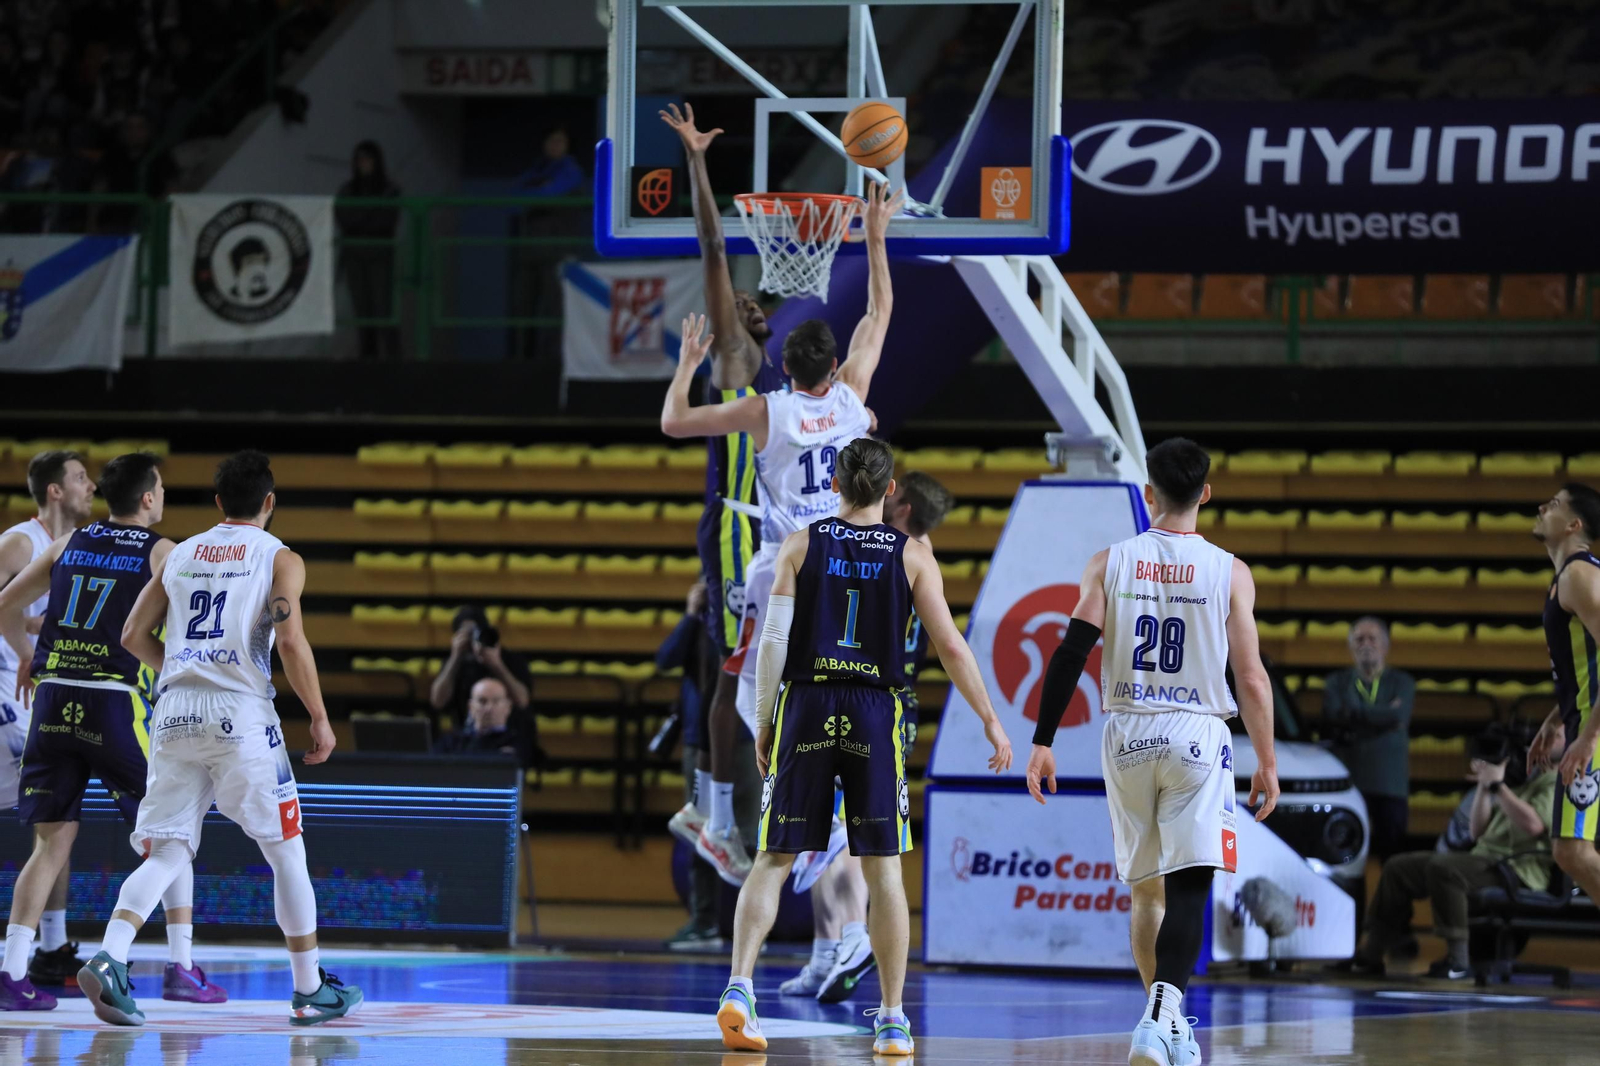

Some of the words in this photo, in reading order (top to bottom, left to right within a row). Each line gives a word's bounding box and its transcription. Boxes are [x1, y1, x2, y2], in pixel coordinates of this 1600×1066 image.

[426, 57, 533, 84] SAIDA
[1245, 205, 1460, 245] Hyupersa
[799, 446, 836, 494] 13
[193, 544, 247, 563] FAGGIANO
[861, 541, 894, 553] booking
[827, 557, 883, 580] MOODY
[1136, 560, 1195, 584] BARCELLO
[58, 574, 117, 630] 17
[1118, 591, 1159, 603] indupanel
[186, 590, 227, 640] 21
[837, 588, 862, 648] 1
[1132, 614, 1186, 674] 28
[38, 723, 72, 733] Abrente
[164, 713, 203, 726] Coruña
[795, 738, 836, 754] Abrente
[840, 738, 870, 754] Dixital
[1118, 743, 1125, 755] A
[1129, 734, 1170, 750] Coruña
[1014, 886, 1132, 912] Parade
